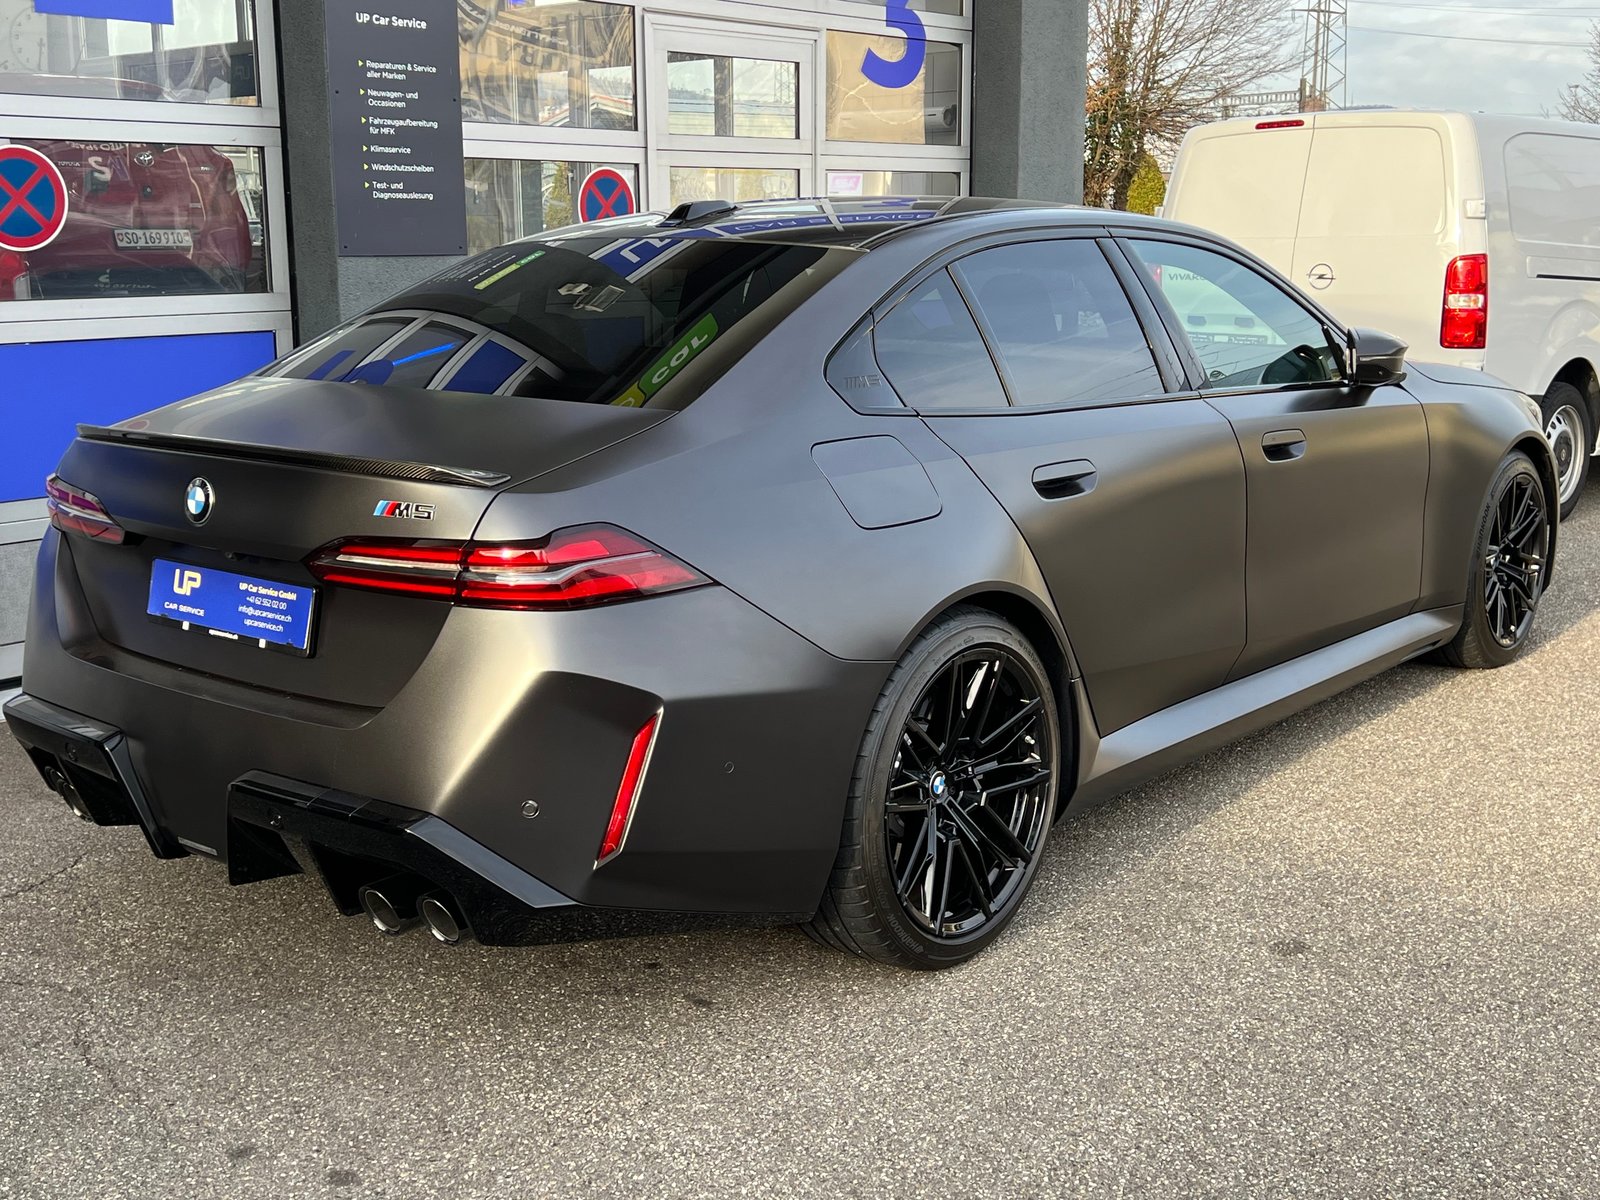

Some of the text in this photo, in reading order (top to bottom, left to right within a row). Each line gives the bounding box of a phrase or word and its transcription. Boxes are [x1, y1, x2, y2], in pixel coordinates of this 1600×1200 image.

[355, 12, 427, 29] UP Car Service
[366, 60, 406, 72] Reparaturen
[413, 64, 437, 73] Service
[366, 70, 406, 80] aller Marken
[367, 89, 418, 99] Neuwagen- und
[368, 99, 406, 108] Occasionen
[369, 117, 438, 129] Fahrzeugaufbereitung
[369, 126, 396, 135] für MFK
[370, 145, 411, 154] Klimaservice
[371, 163, 434, 173] Windschutzscheiben
[372, 181, 403, 190] Test- und
[373, 191, 433, 200] Diagnoseauslesung
[173, 568, 202, 596] UP
[239, 582, 297, 601] UP Car Service GmbH
[164, 601, 205, 617] CAR SERVICE
[255, 596, 262, 605] 62
[262, 598, 271, 607] 552
[272, 600, 279, 609] 02
[279, 602, 287, 610] 00
[238, 604, 292, 623] info@upcarservice.ch
[243, 618, 284, 632] upcarservice.ch
